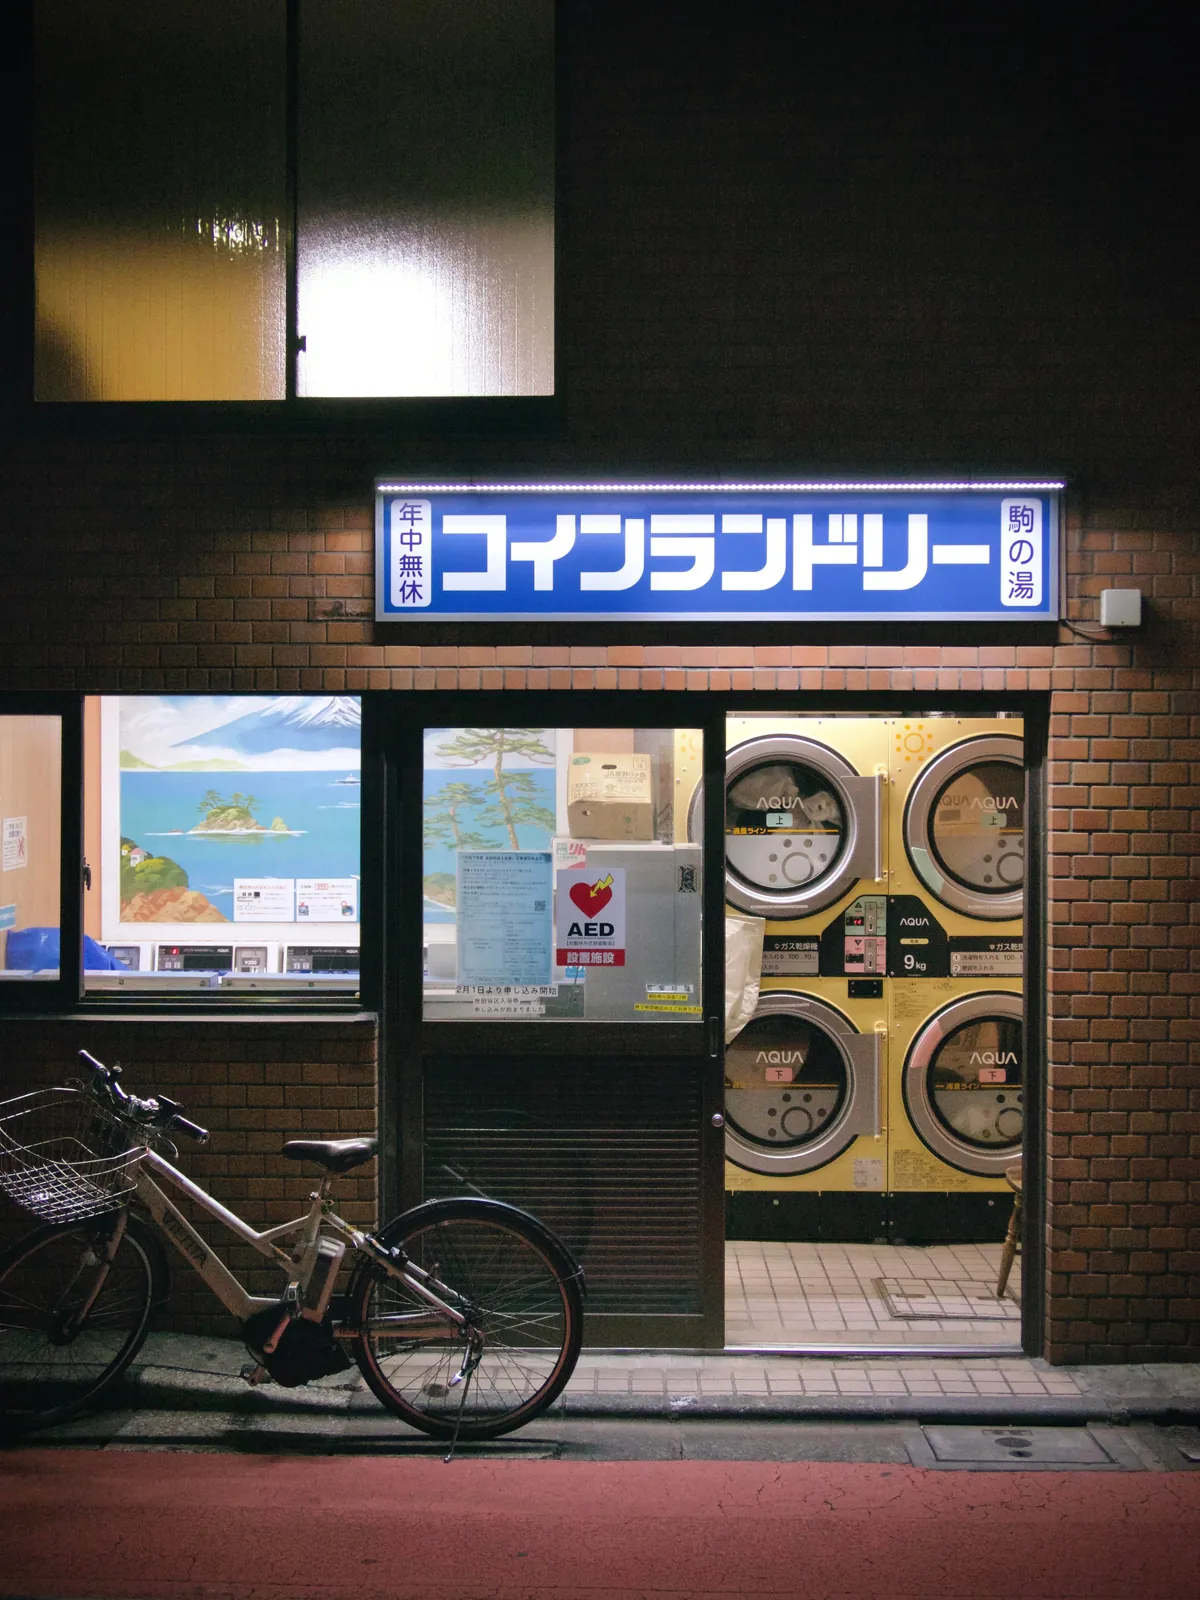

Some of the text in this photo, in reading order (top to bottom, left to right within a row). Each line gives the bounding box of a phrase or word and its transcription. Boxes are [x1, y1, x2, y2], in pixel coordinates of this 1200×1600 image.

[399, 503, 423, 604] 年中無休
[442, 514, 990, 591] コインランドリー
[1008, 505, 1035, 599] 駒の湯
[756, 796, 804, 809] AQUA
[970, 796, 1019, 809] AQUA
[776, 815, 783, 825] 上
[989, 815, 997, 825] 上
[900, 918, 930, 926] AQUA
[567, 922, 615, 937] AED
[567, 952, 615, 964] 設置施設
[456, 985, 557, 995] 2月1日より申し込み開始
[756, 1051, 804, 1064] AQUA
[969, 1051, 1018, 1065] AQUA
[775, 1070, 783, 1079] 下
[988, 1070, 997, 1080] 下
